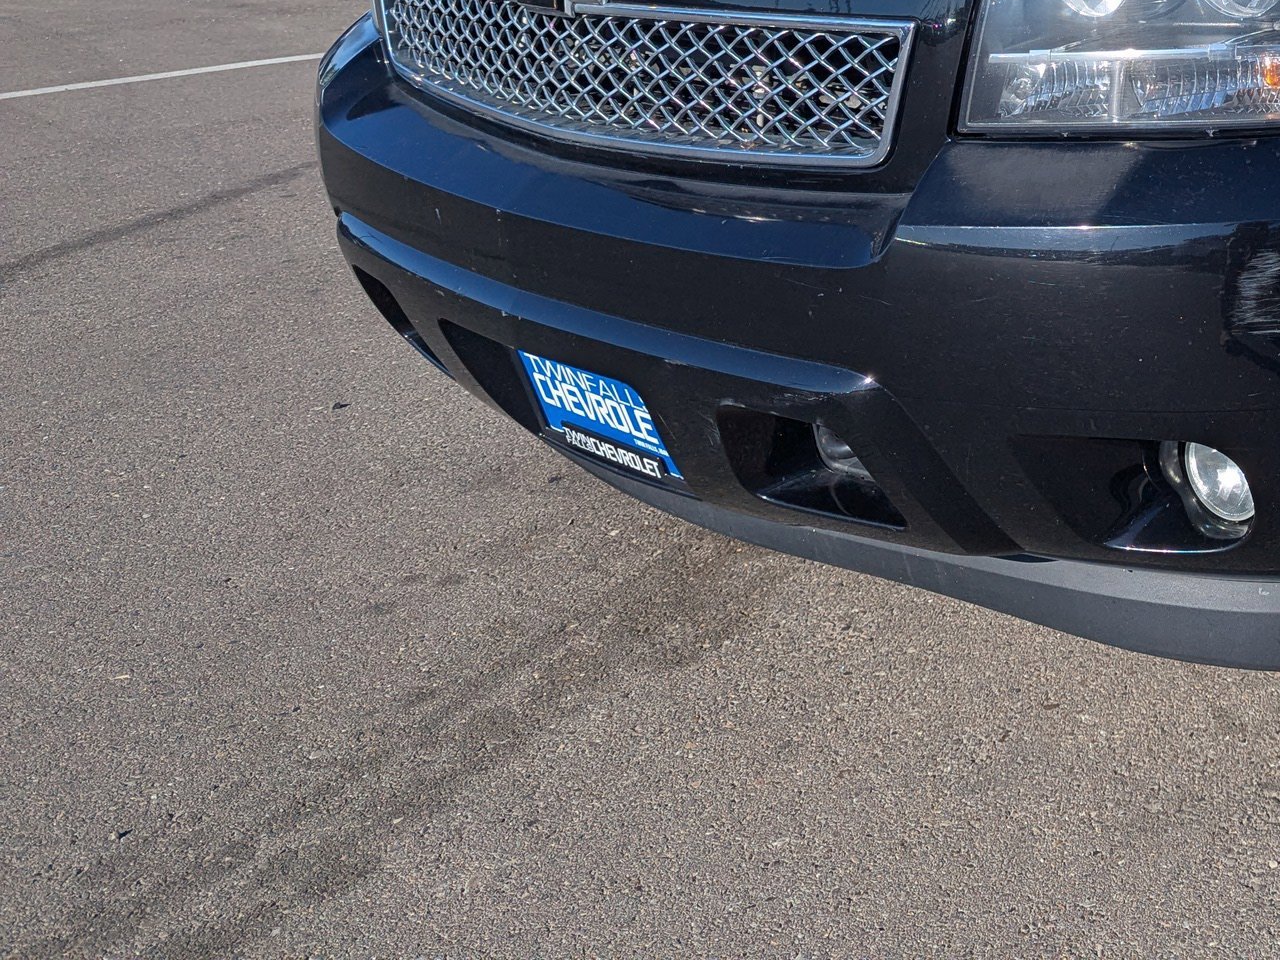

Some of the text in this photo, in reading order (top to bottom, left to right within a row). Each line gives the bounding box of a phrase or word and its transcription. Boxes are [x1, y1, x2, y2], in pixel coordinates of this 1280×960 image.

[524, 353, 648, 413] TWIN FALL
[533, 372, 659, 444] CHEVROLE
[590, 437, 661, 478] CHEVROLET
